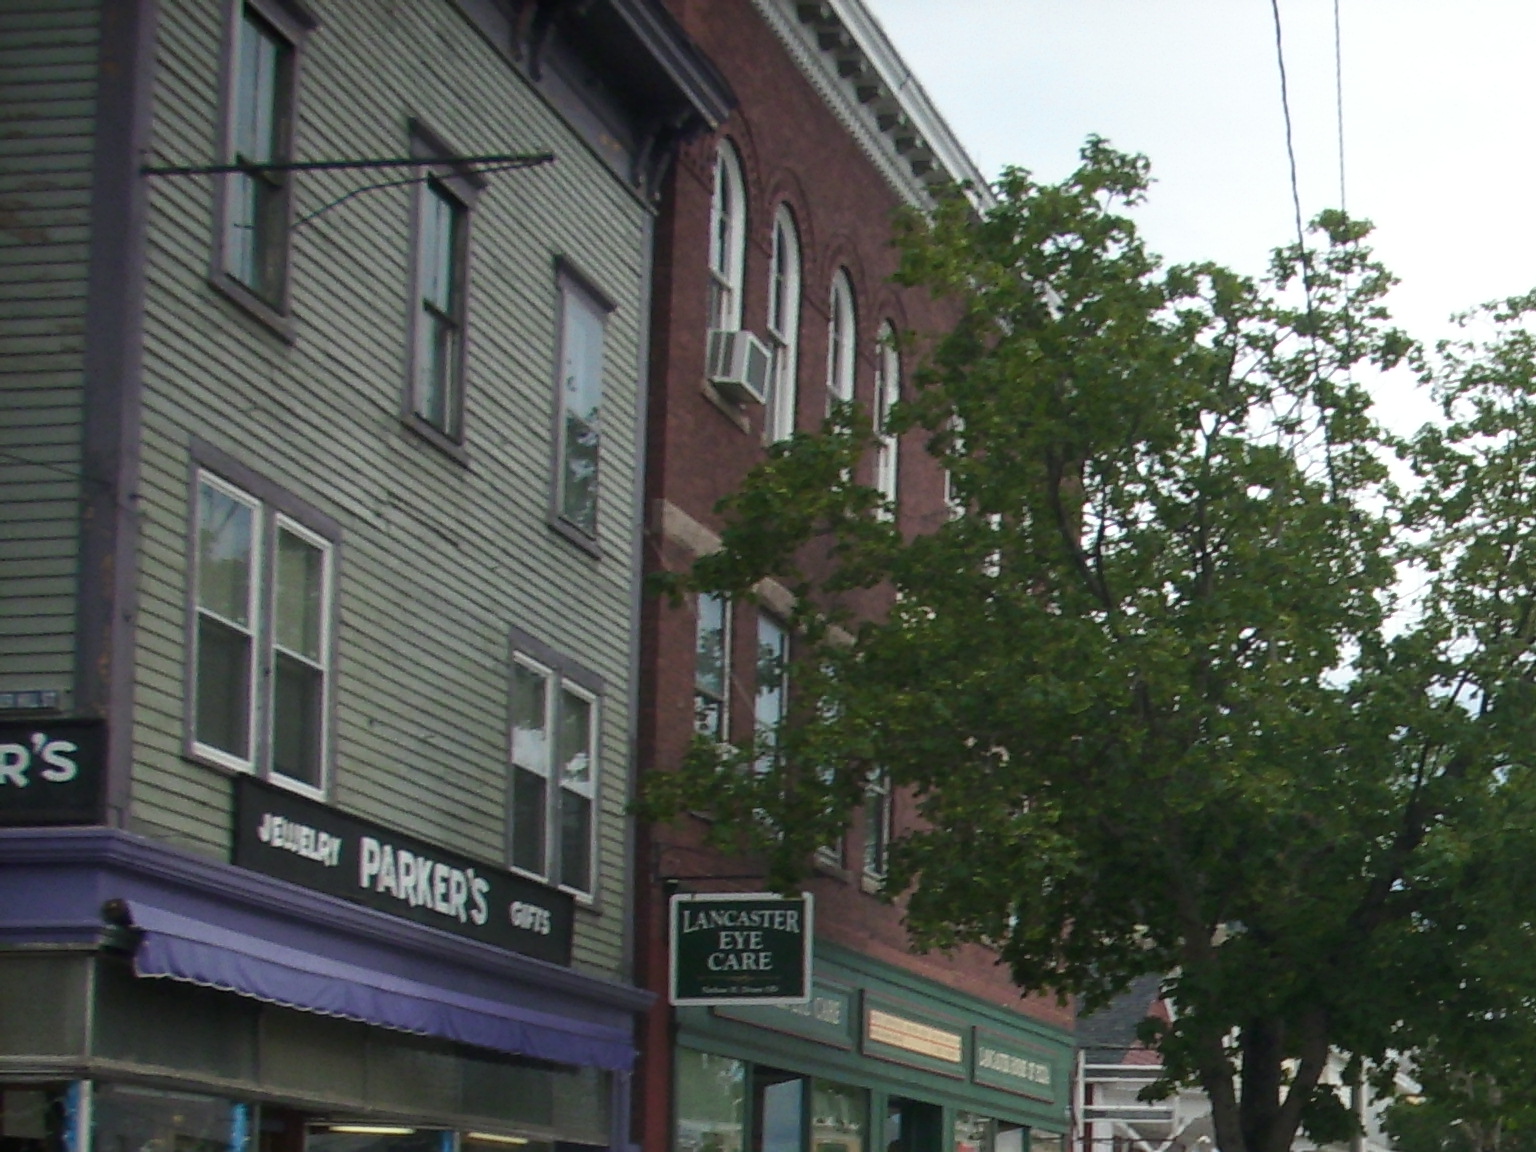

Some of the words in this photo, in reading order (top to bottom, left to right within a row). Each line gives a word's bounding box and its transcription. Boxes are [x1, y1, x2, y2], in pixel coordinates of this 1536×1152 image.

[257, 813, 342, 867] JEWELRY
[358, 836, 490, 925] PARKER'S
[509, 900, 551, 935] GIFTS
[683, 910, 800, 933] LANCASTER
[719, 931, 765, 950] EYE
[707, 951, 774, 972] CARE
